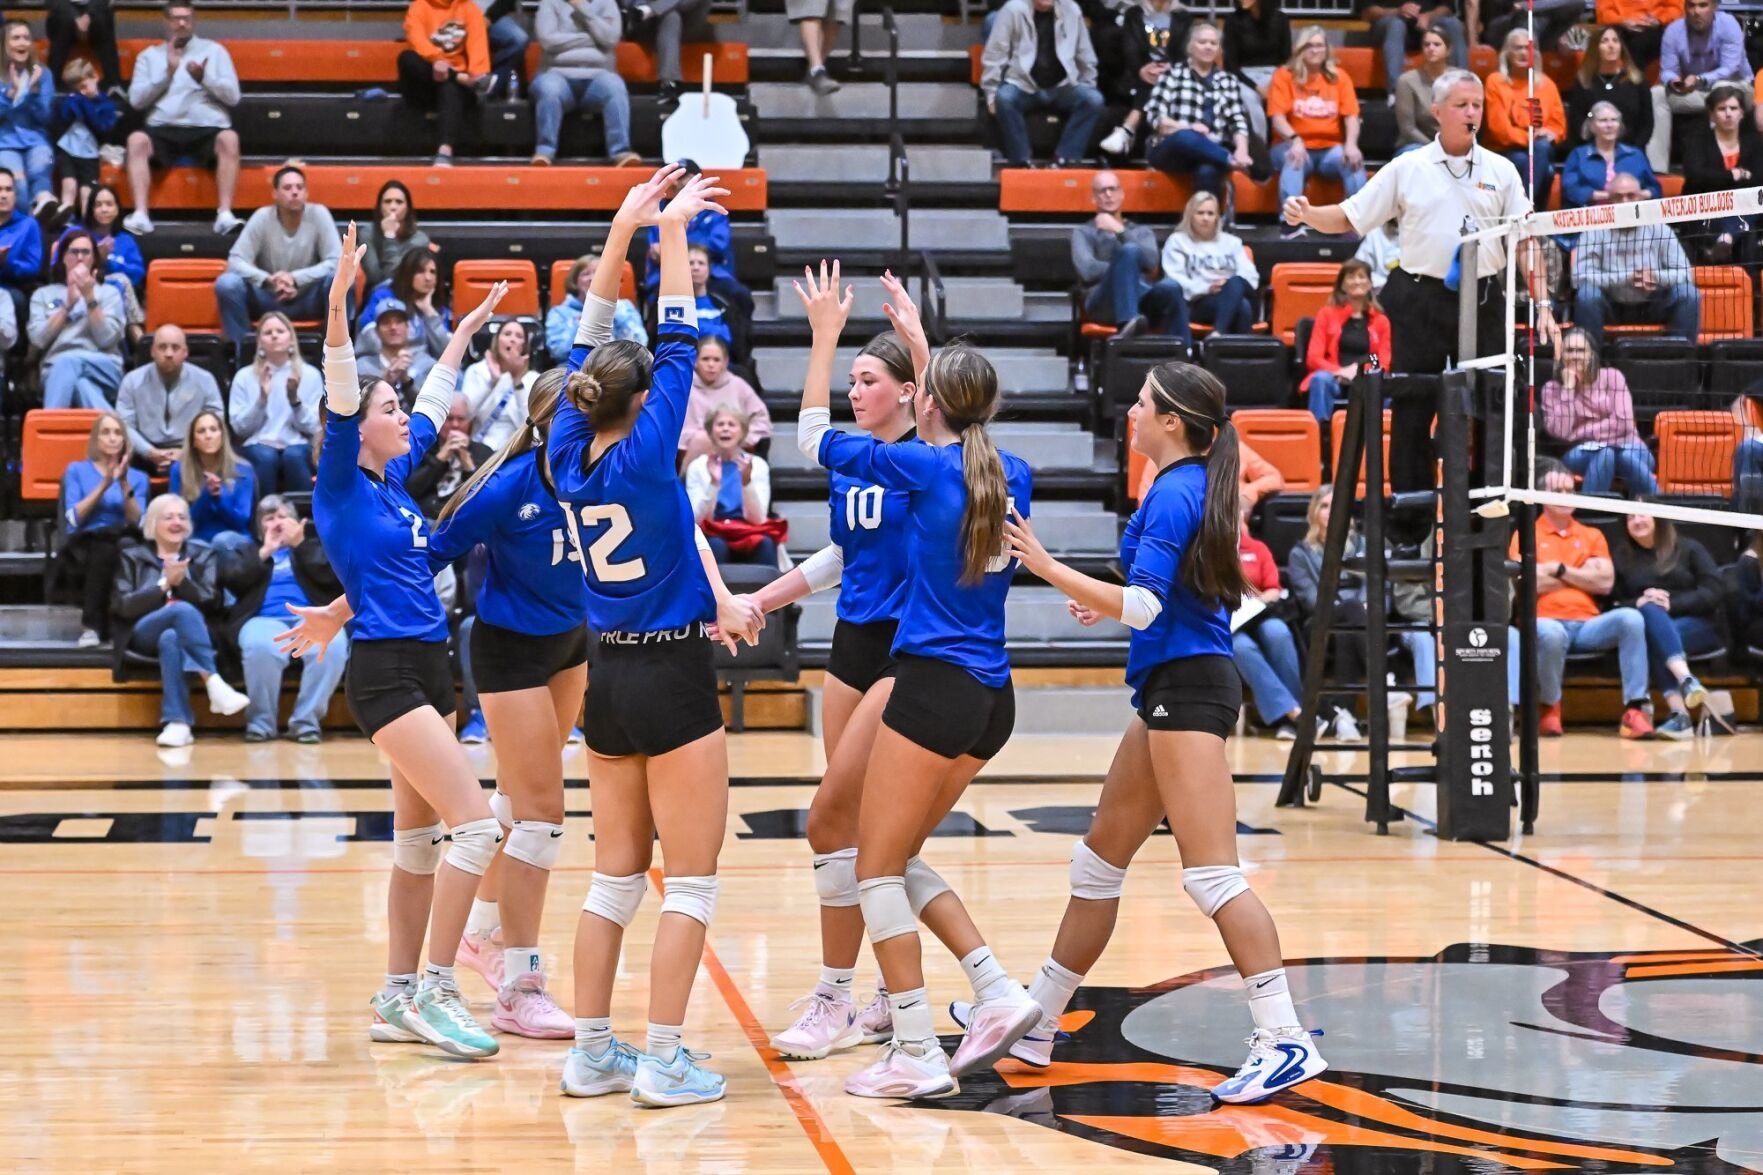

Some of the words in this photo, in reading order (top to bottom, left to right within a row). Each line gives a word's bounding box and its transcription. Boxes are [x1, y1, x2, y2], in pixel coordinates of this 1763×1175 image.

[1660, 196, 1697, 218] WATERLOO
[1699, 191, 1734, 213] BULLDOGS
[399, 506, 428, 548] 2
[846, 485, 885, 531] 10
[557, 500, 647, 582] 12
